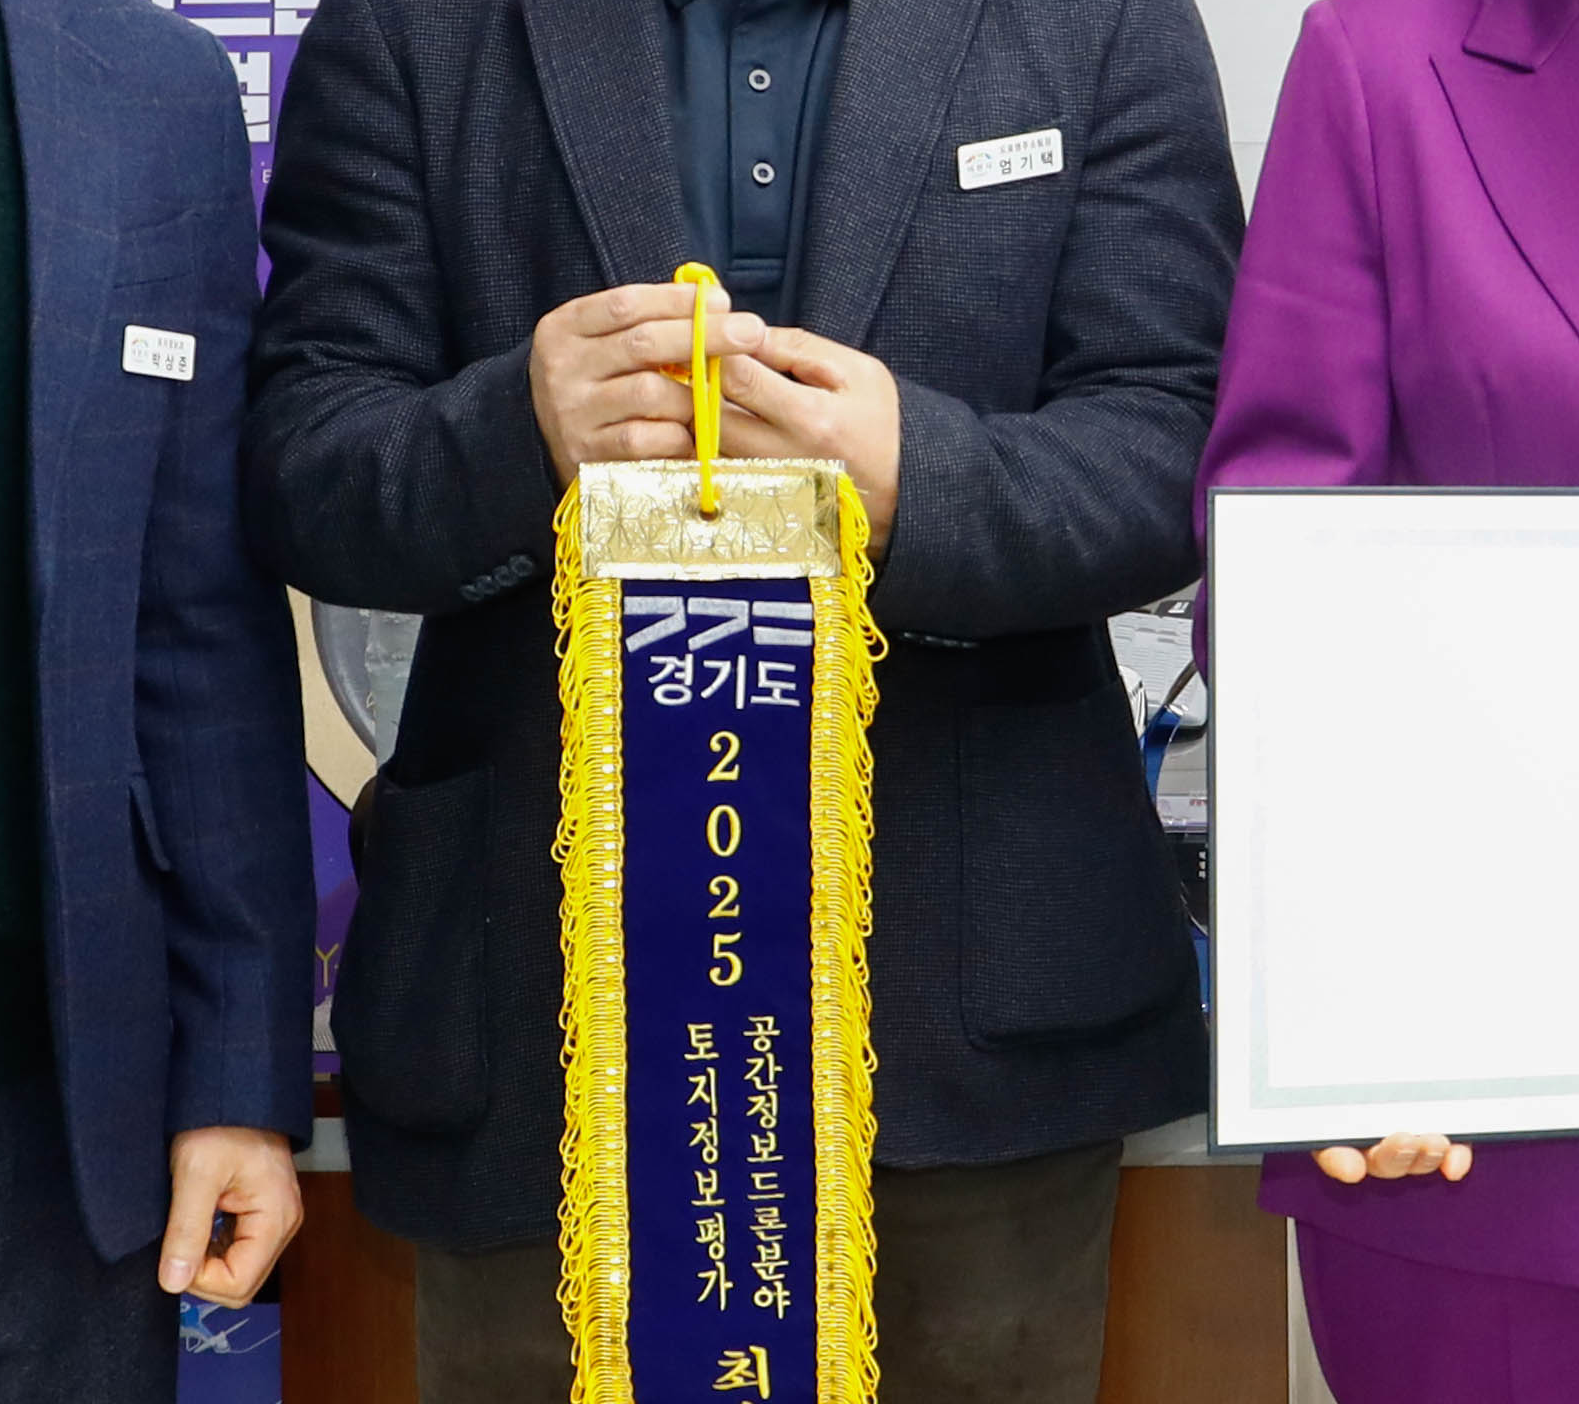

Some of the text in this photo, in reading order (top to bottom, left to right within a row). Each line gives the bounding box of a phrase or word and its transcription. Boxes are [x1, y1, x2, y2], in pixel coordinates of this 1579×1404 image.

[648, 653, 801, 710] 경기도
[706, 730, 743, 987] 2025
[683, 1020, 734, 1314] 토지정보평가
